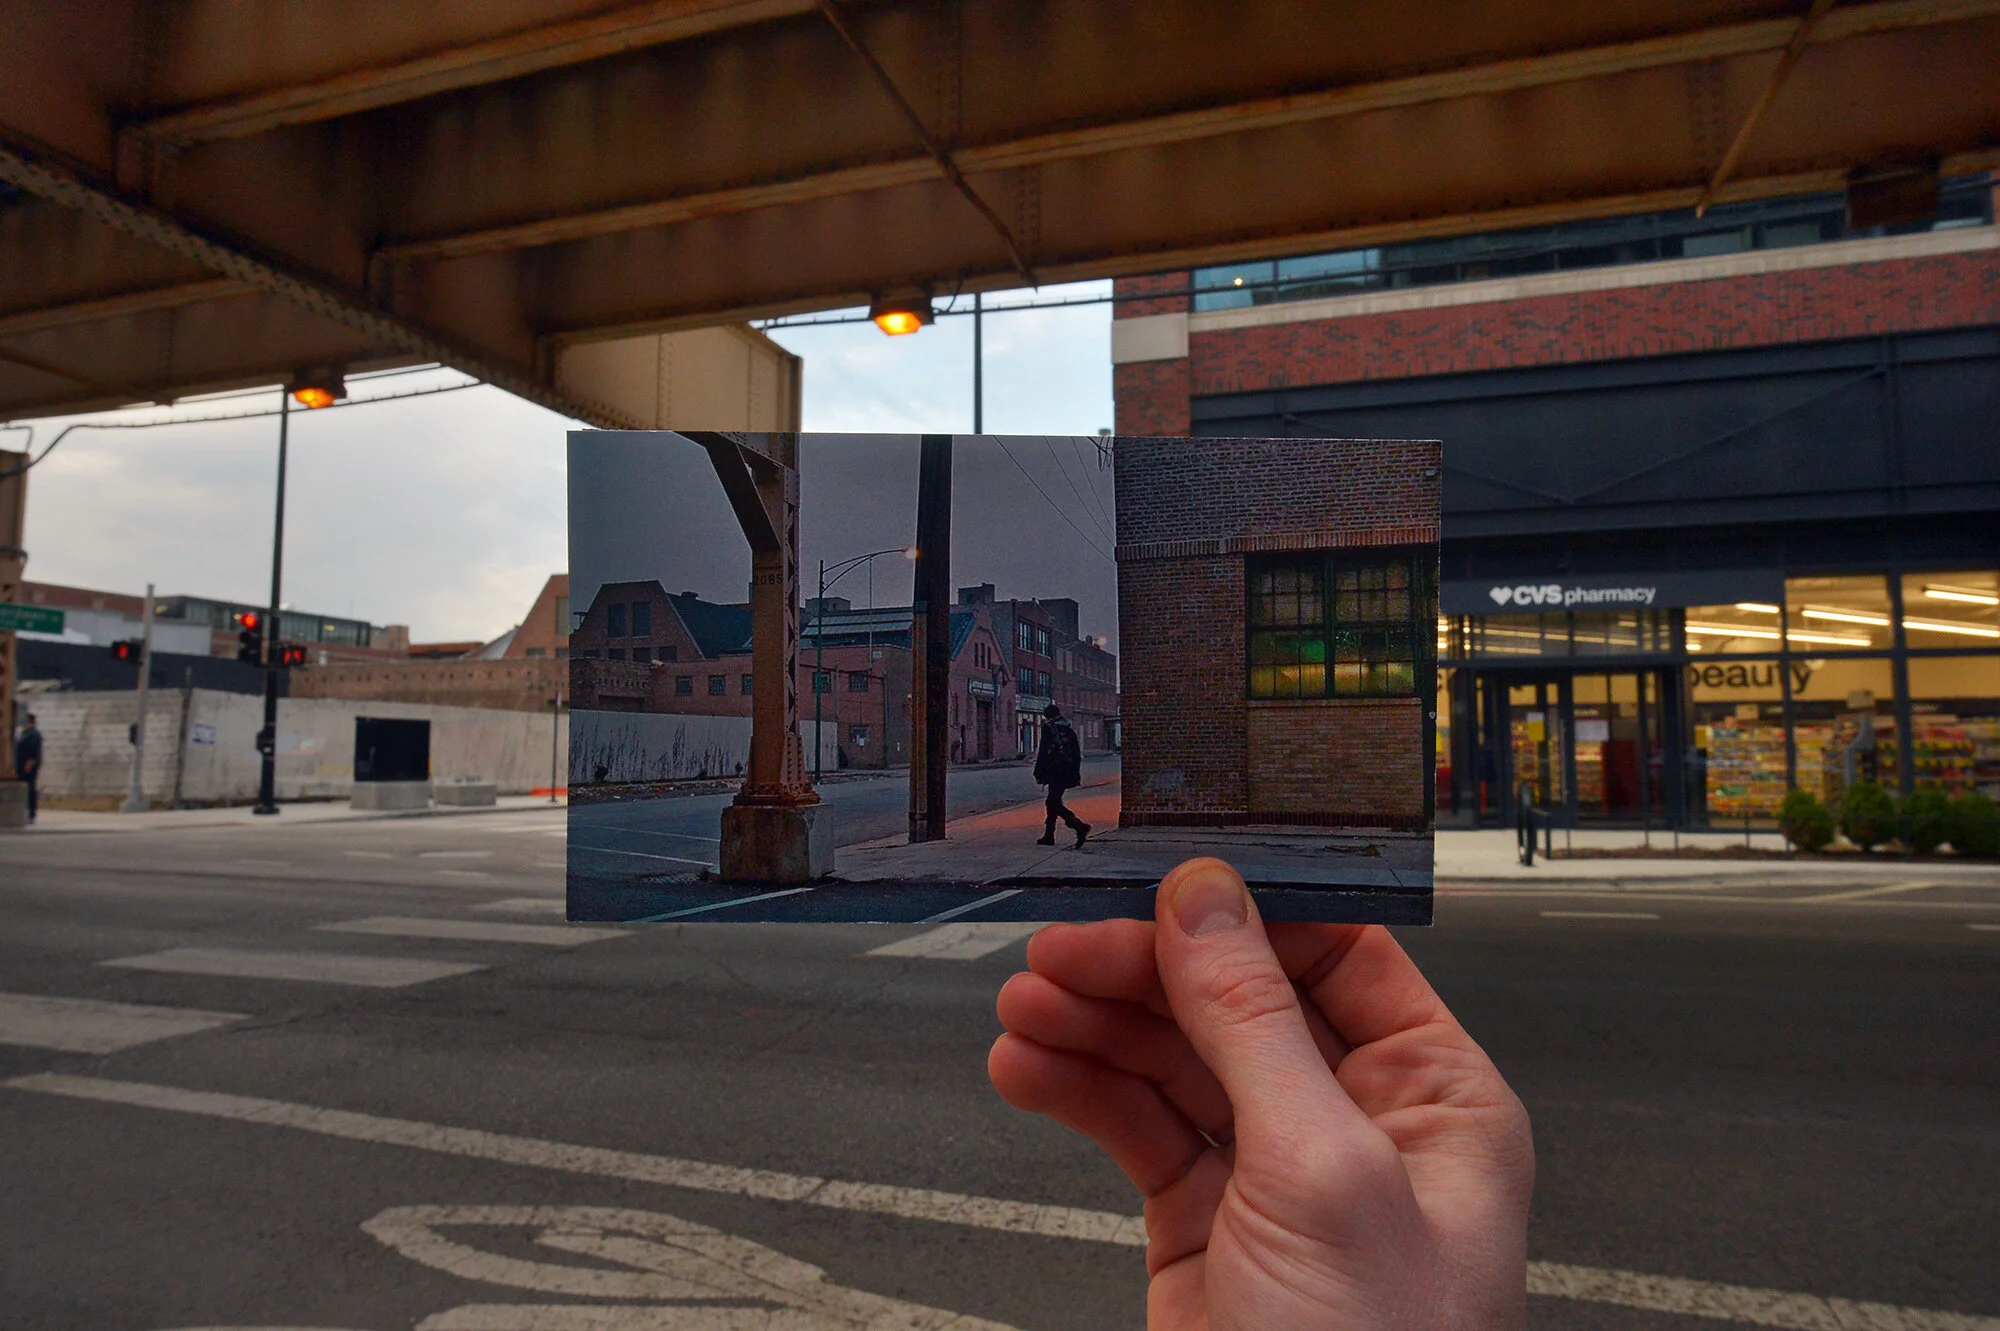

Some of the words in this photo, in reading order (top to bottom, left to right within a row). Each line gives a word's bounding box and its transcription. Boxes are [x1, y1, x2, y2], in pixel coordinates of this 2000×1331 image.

[1513, 584, 1563, 606] CVS
[1564, 587, 1657, 607] pharmacy
[1687, 664, 1812, 694] eauy
